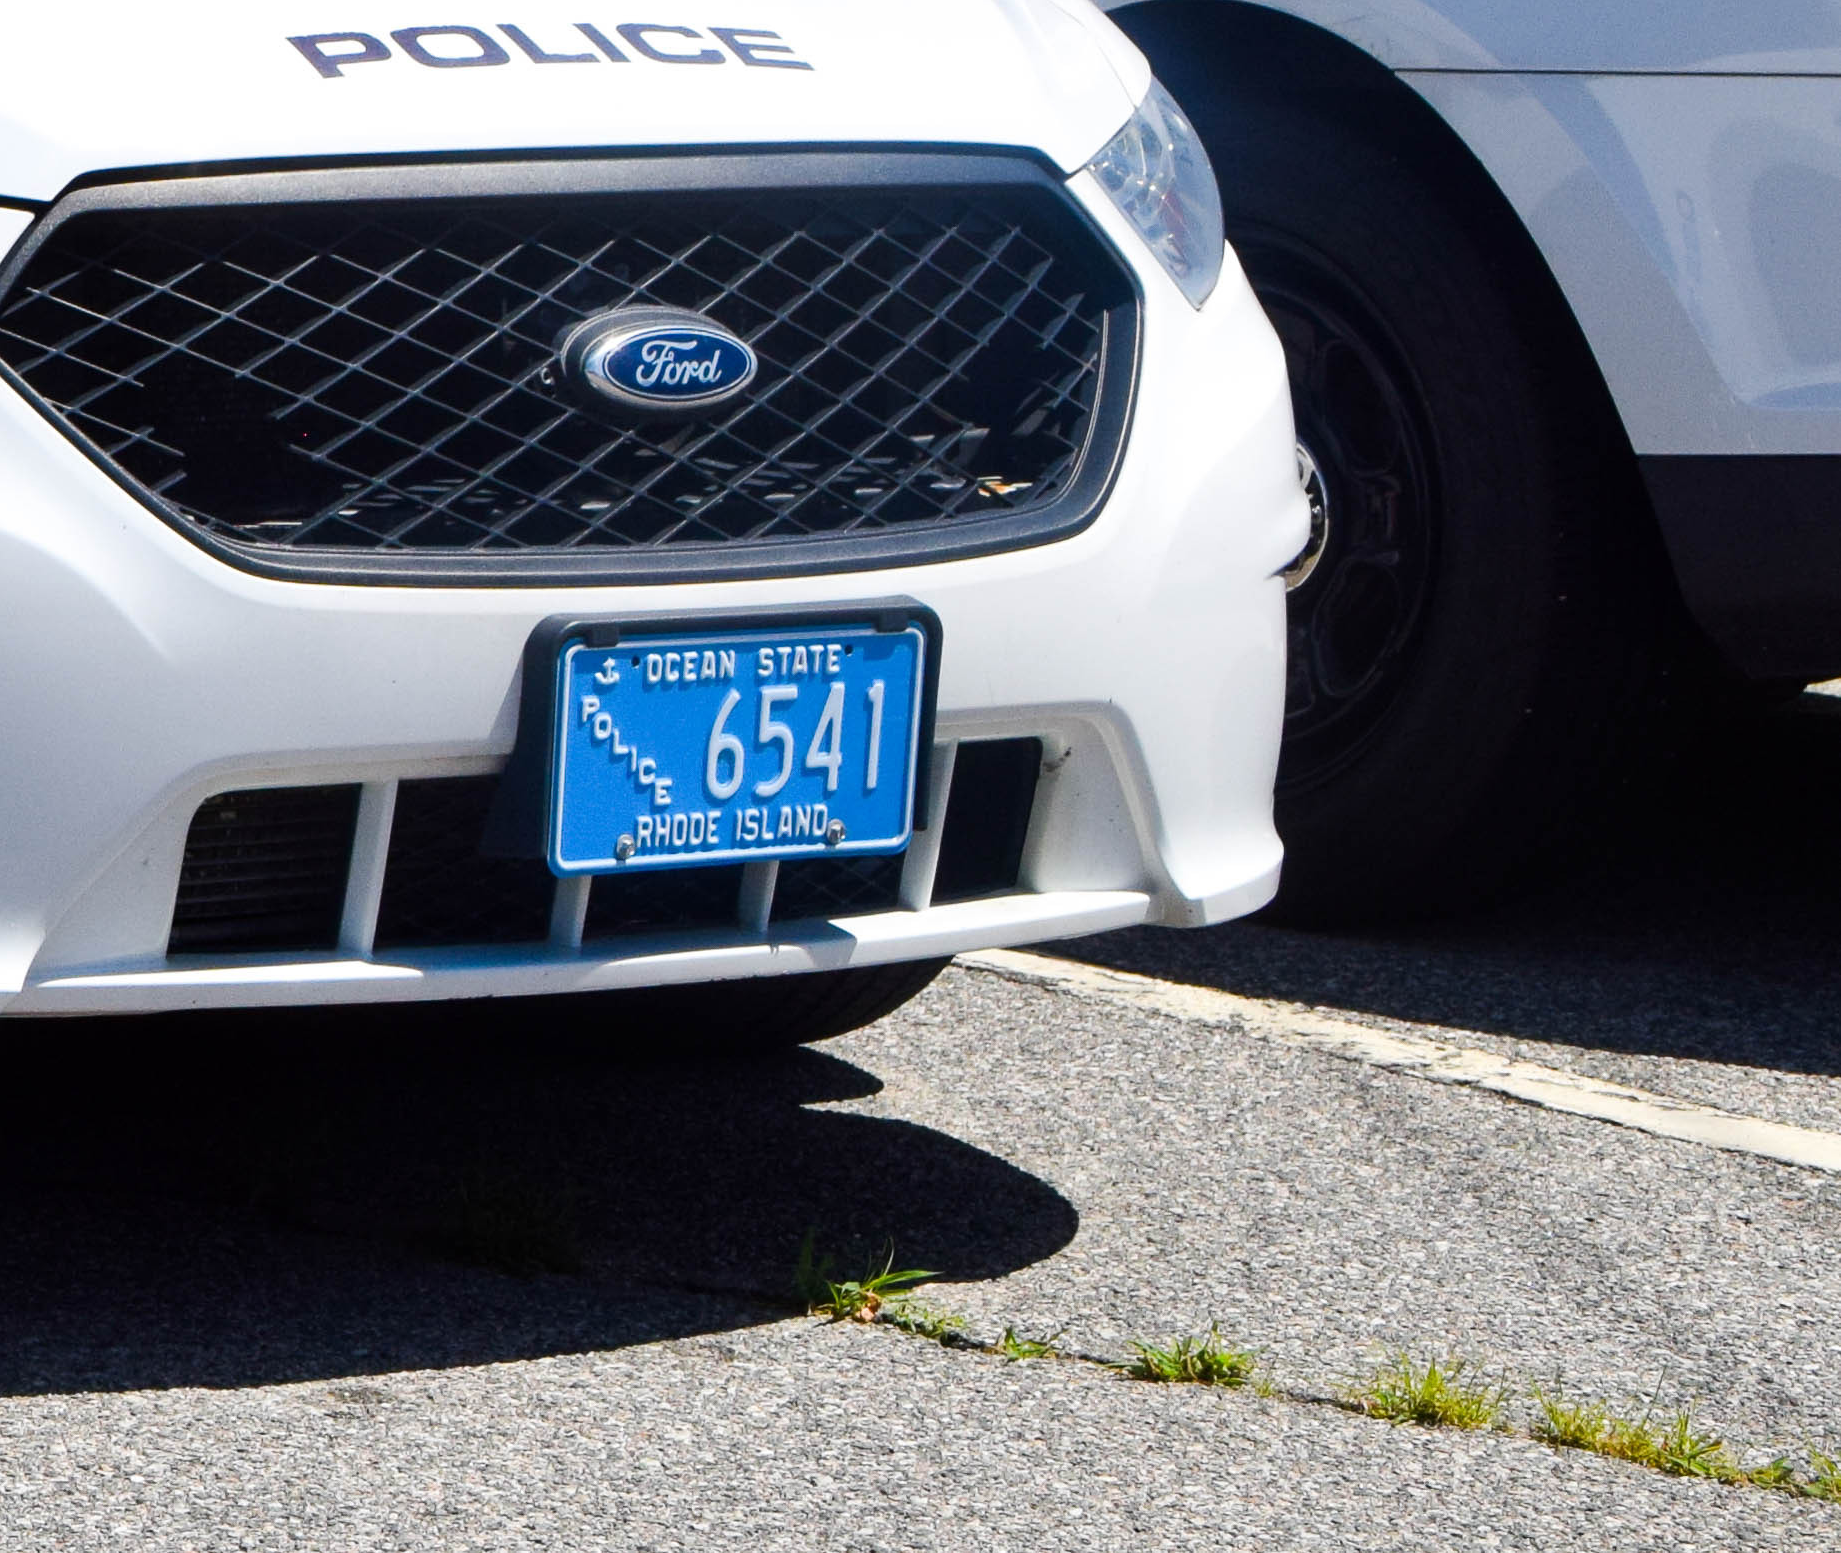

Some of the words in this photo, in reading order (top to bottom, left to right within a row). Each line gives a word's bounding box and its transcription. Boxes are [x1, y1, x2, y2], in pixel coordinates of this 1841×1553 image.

[285, 22, 815, 78] POLICE
[635, 339, 723, 387] Ford
[646, 649, 735, 684] OCEAN
[757, 644, 842, 678] STATE
[581, 696, 672, 806] POLICE
[706, 679, 886, 800] 6541
[636, 811, 720, 848] RHODE
[735, 804, 829, 842] ISLAND
